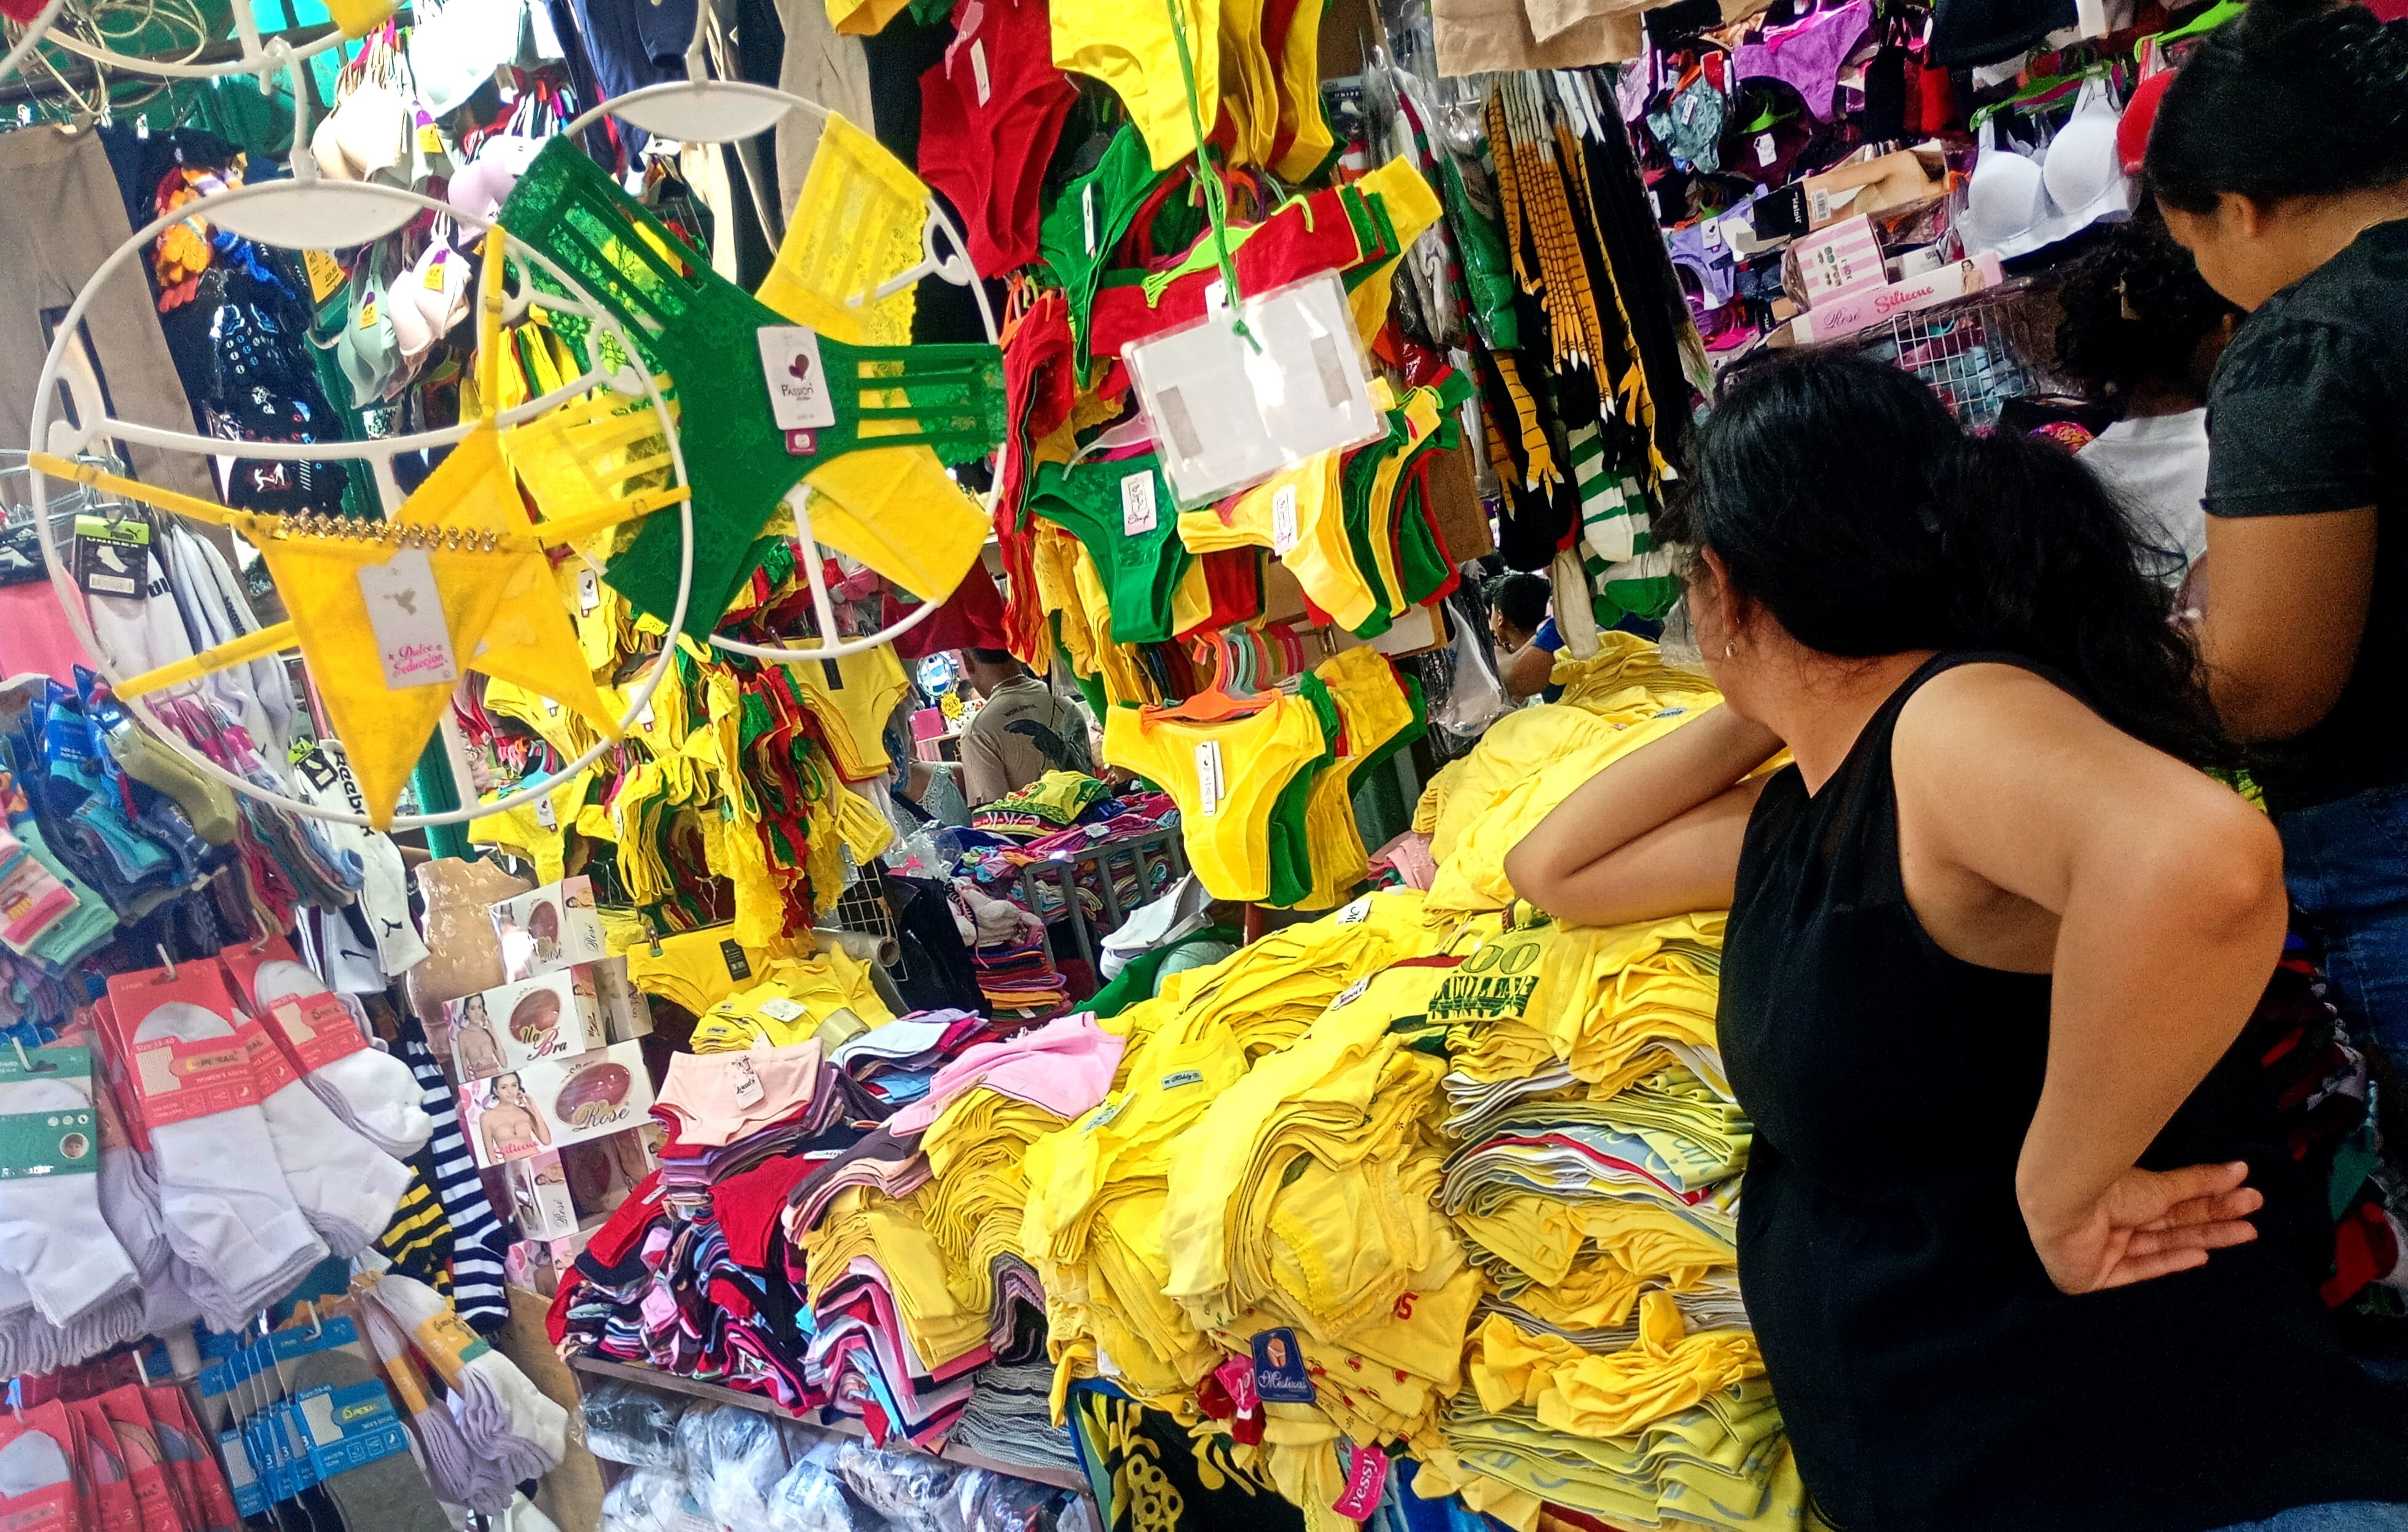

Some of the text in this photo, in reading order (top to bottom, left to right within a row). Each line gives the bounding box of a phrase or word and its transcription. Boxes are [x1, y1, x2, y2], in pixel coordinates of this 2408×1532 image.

[1874, 285, 1934, 314] Silicone
[572, 1105, 630, 1133] Rose
[493, 1141, 539, 1160] Silicone
[265, 1453, 274, 1467] 3
[1349, 1453, 1378, 1514] yessy
[124, 1508, 134, 1521] 3
